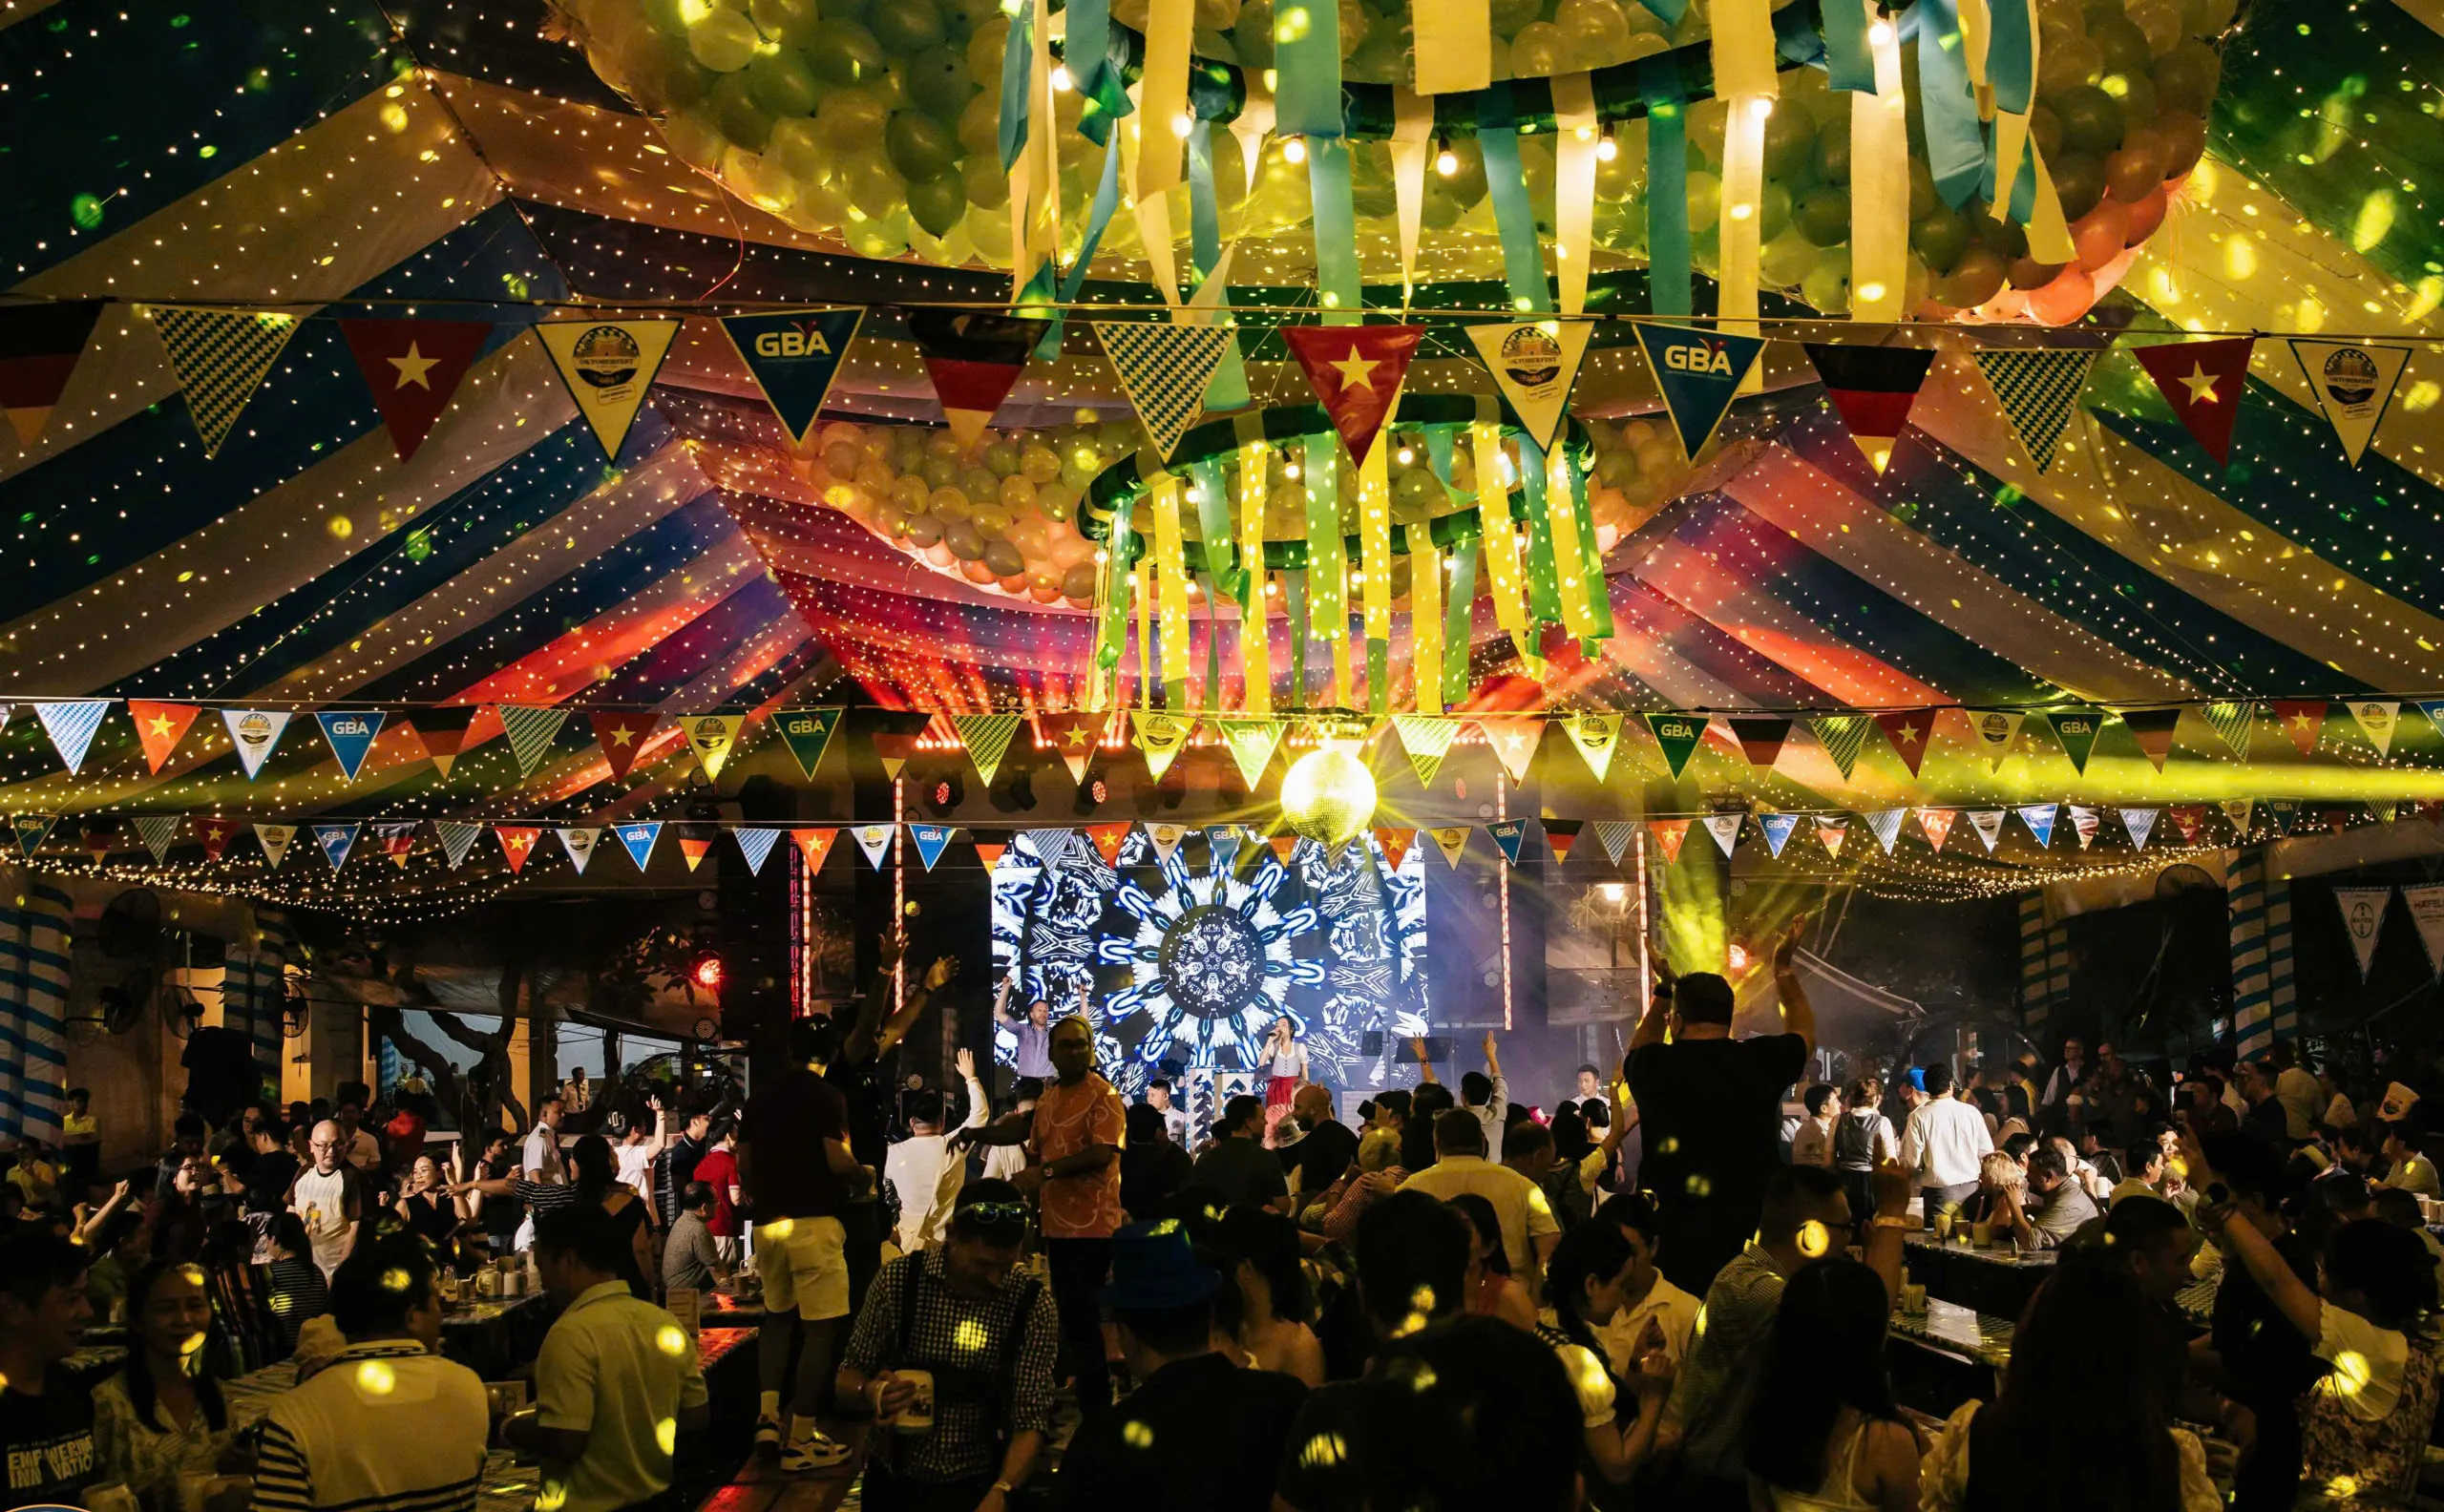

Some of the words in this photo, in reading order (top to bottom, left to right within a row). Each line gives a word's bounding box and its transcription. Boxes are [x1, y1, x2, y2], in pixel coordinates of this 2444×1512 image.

[755, 329, 832, 357] GBA
[1664, 345, 1734, 376] GBA
[332, 721, 370, 735] GBA
[789, 719, 826, 734] GBA
[1661, 724, 1695, 738] GBA
[2060, 721, 2092, 734] GBA
[2274, 802, 2292, 810] GBA
[19, 820, 44, 830] GBA
[1766, 819, 1788, 830] GBA
[324, 831, 348, 841] GBA
[626, 830, 651, 841] GBA
[919, 830, 943, 842] GBA
[1212, 830, 1236, 840] GBA
[1496, 826, 1520, 837] GBA
